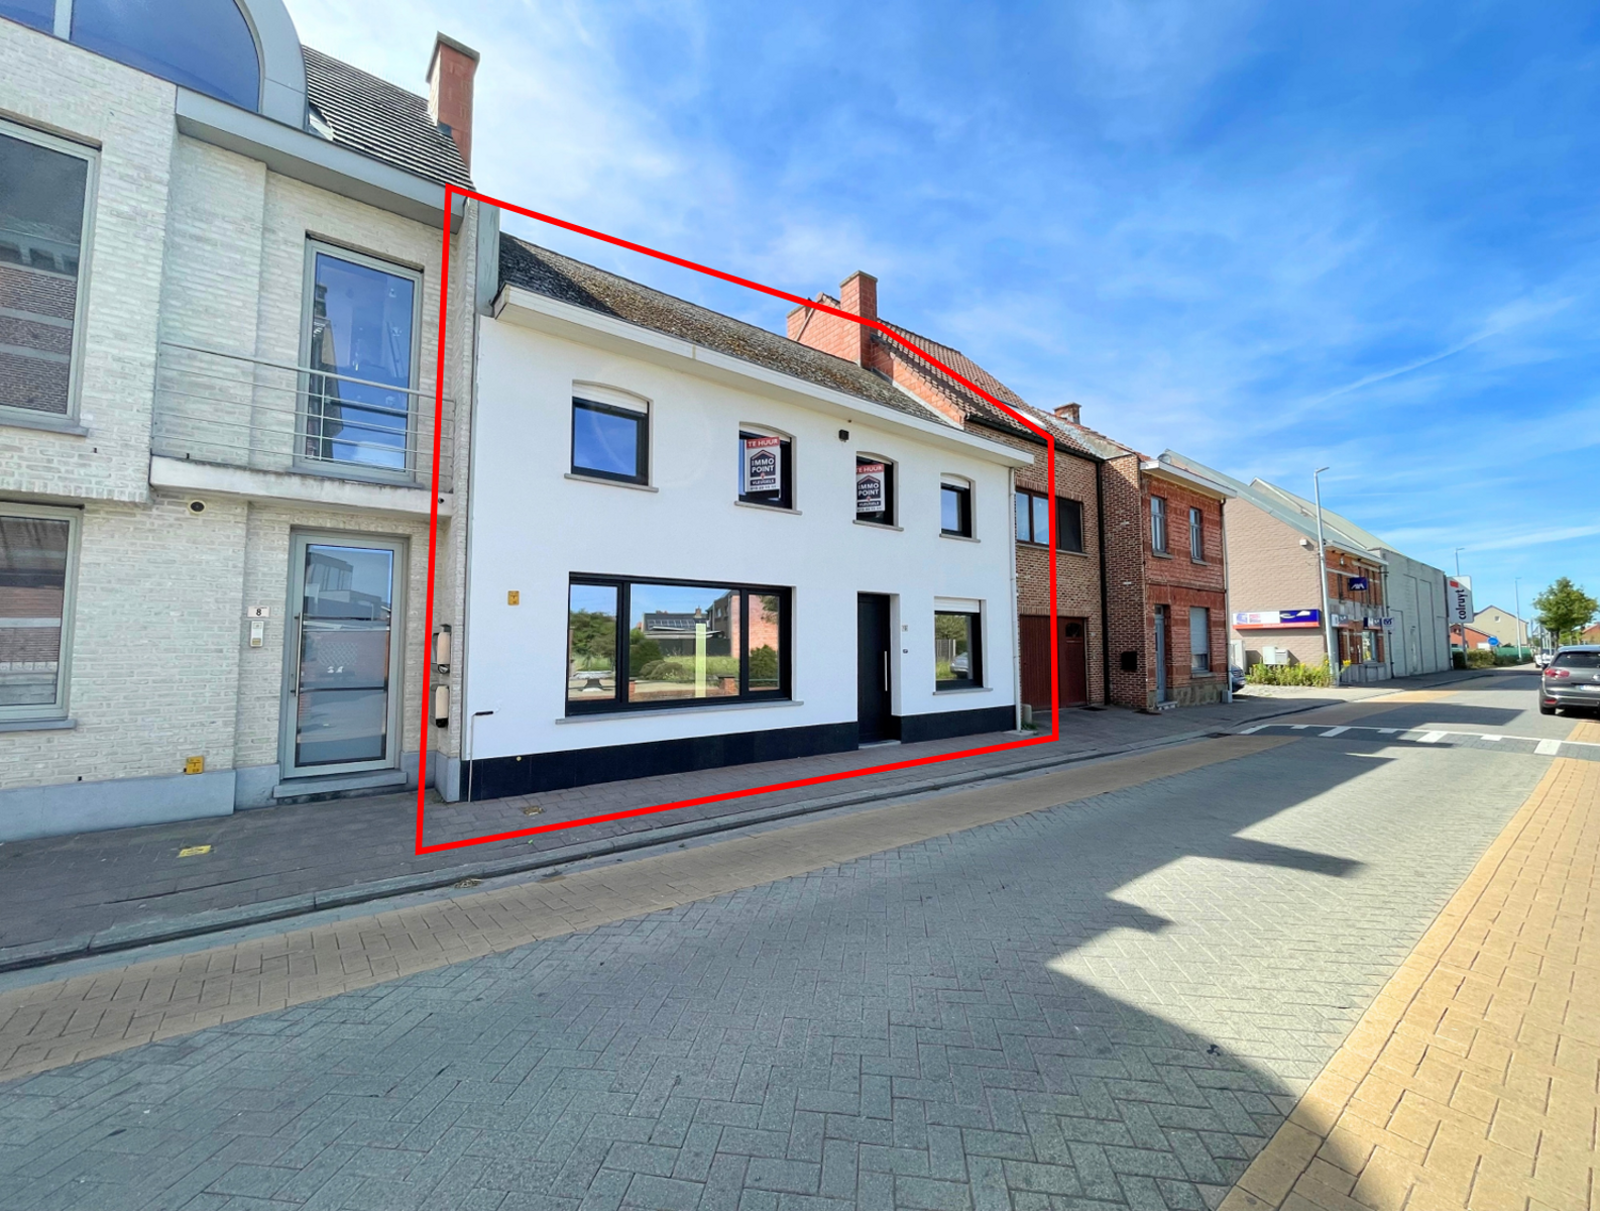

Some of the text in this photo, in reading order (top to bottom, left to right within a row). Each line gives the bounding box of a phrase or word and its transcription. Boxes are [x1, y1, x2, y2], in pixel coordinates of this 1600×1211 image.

[758, 438, 778, 446] HUUR
[751, 458, 774, 466] IMMO
[751, 465, 774, 473] POINT
[1455, 589, 1468, 620] colruyt
[256, 608, 262, 617] 8
